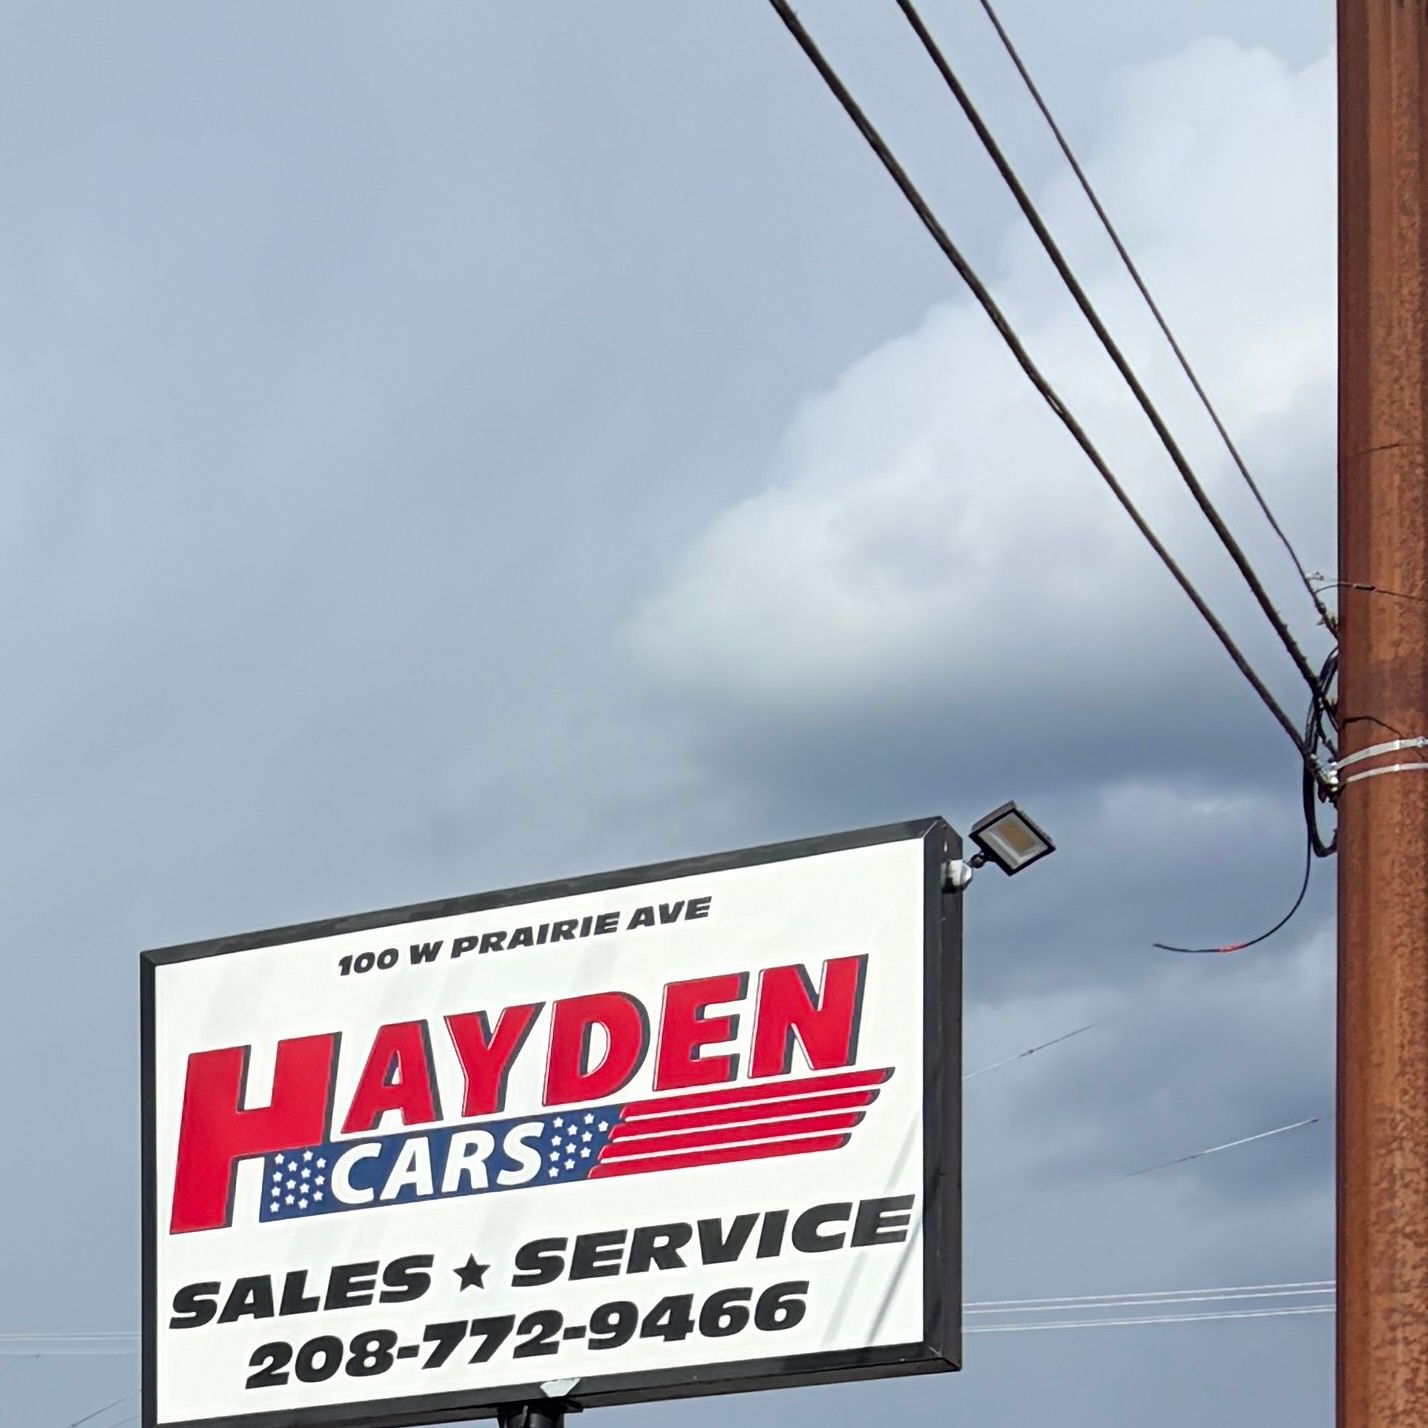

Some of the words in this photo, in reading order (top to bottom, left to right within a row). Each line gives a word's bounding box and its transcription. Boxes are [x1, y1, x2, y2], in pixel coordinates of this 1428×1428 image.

[338, 947, 398, 976] 100
[410, 940, 445, 966] W
[451, 909, 621, 959] PRAIRIE
[626, 895, 712, 932] AVE
[169, 953, 869, 1235] HAYDEN
[330, 1119, 546, 1205] CARS
[169, 1254, 435, 1330] SALES
[510, 1194, 915, 1289] SERVICE
[244, 1281, 810, 1390] 208-772-9466
